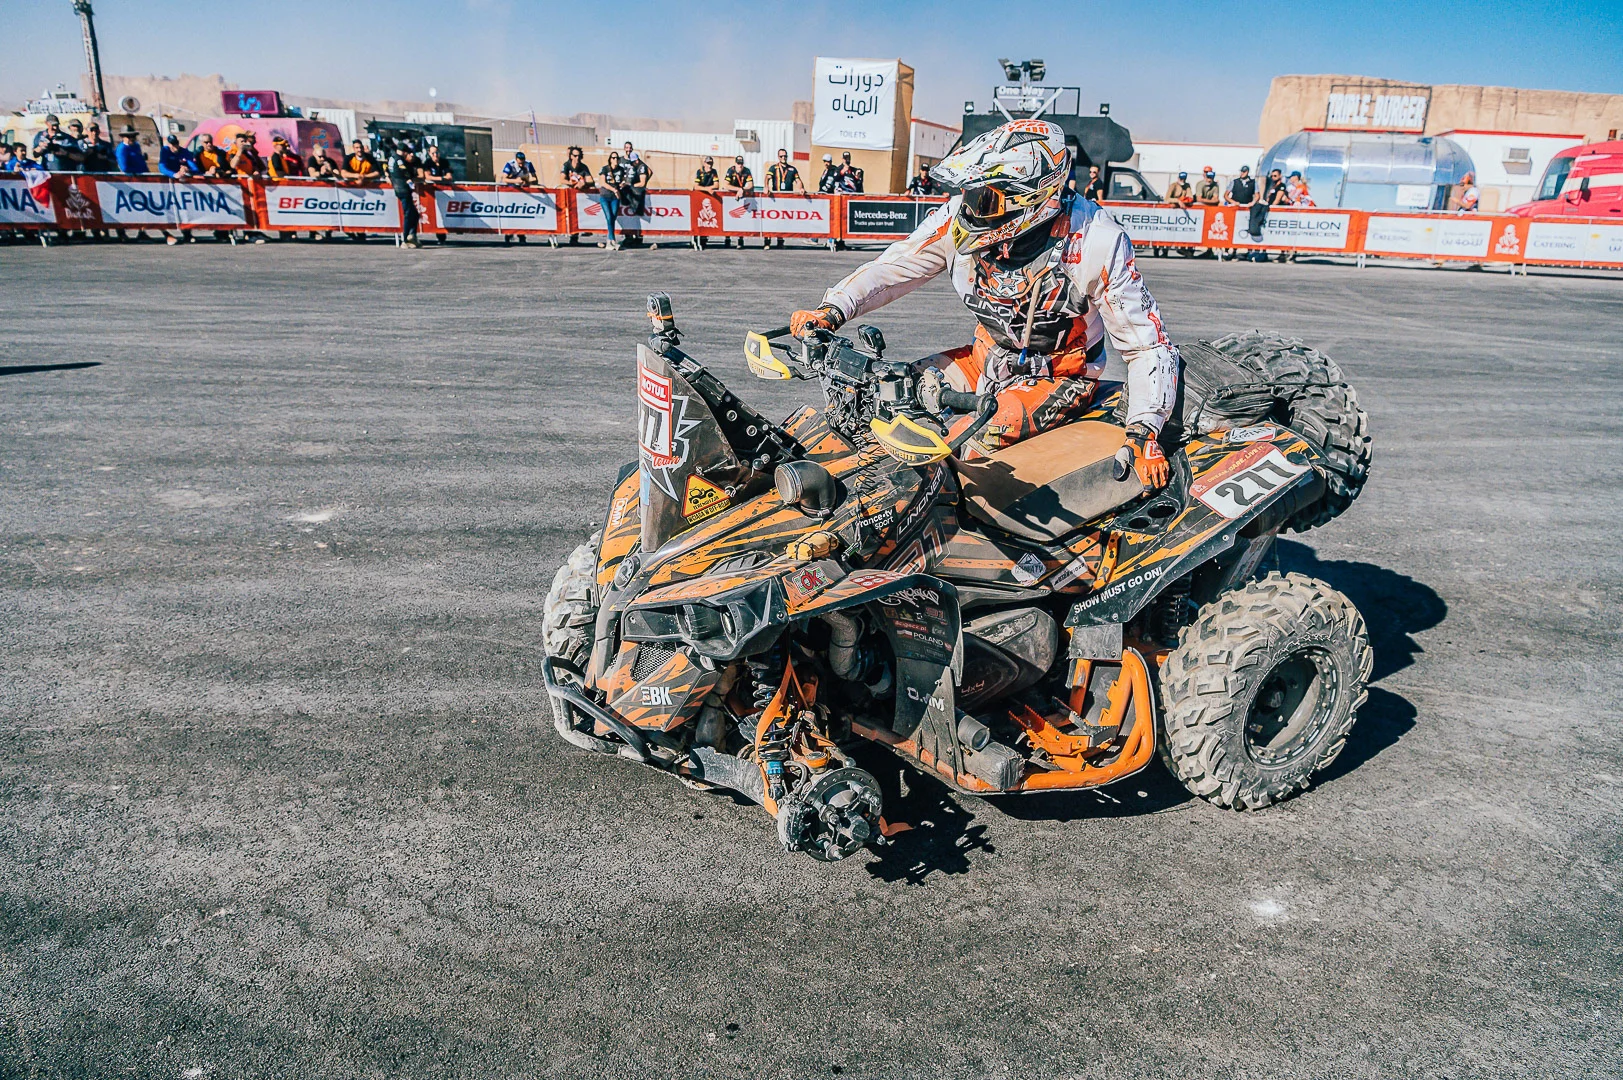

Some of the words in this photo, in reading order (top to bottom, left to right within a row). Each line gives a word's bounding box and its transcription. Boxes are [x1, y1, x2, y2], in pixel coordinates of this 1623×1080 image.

[998, 85, 1020, 95] One
[1022, 86, 1045, 97] Way
[832, 94, 878, 119] المياه
[1327, 93, 1372, 125] TRIPLE
[1372, 94, 1427, 128] BURGER
[840, 130, 867, 139] TOILETS
[115, 189, 232, 216] AQUAFINA
[278, 197, 386, 211] BFGoodrich
[446, 201, 546, 215] BFGoodrich
[751, 209, 824, 221] HONDA
[854, 210, 908, 220] Mercedes-Benz
[1214, 459, 1297, 507] 277
[898, 466, 944, 535] LINDNER
[874, 516, 894, 530] sport
[801, 569, 823, 591] OK
[1073, 595, 1100, 614] SHOW
[1100, 582, 1127, 603] MUST
[1127, 575, 1143, 589] GO
[1143, 567, 1164, 581] ON!
[913, 632, 944, 646] POLAND
